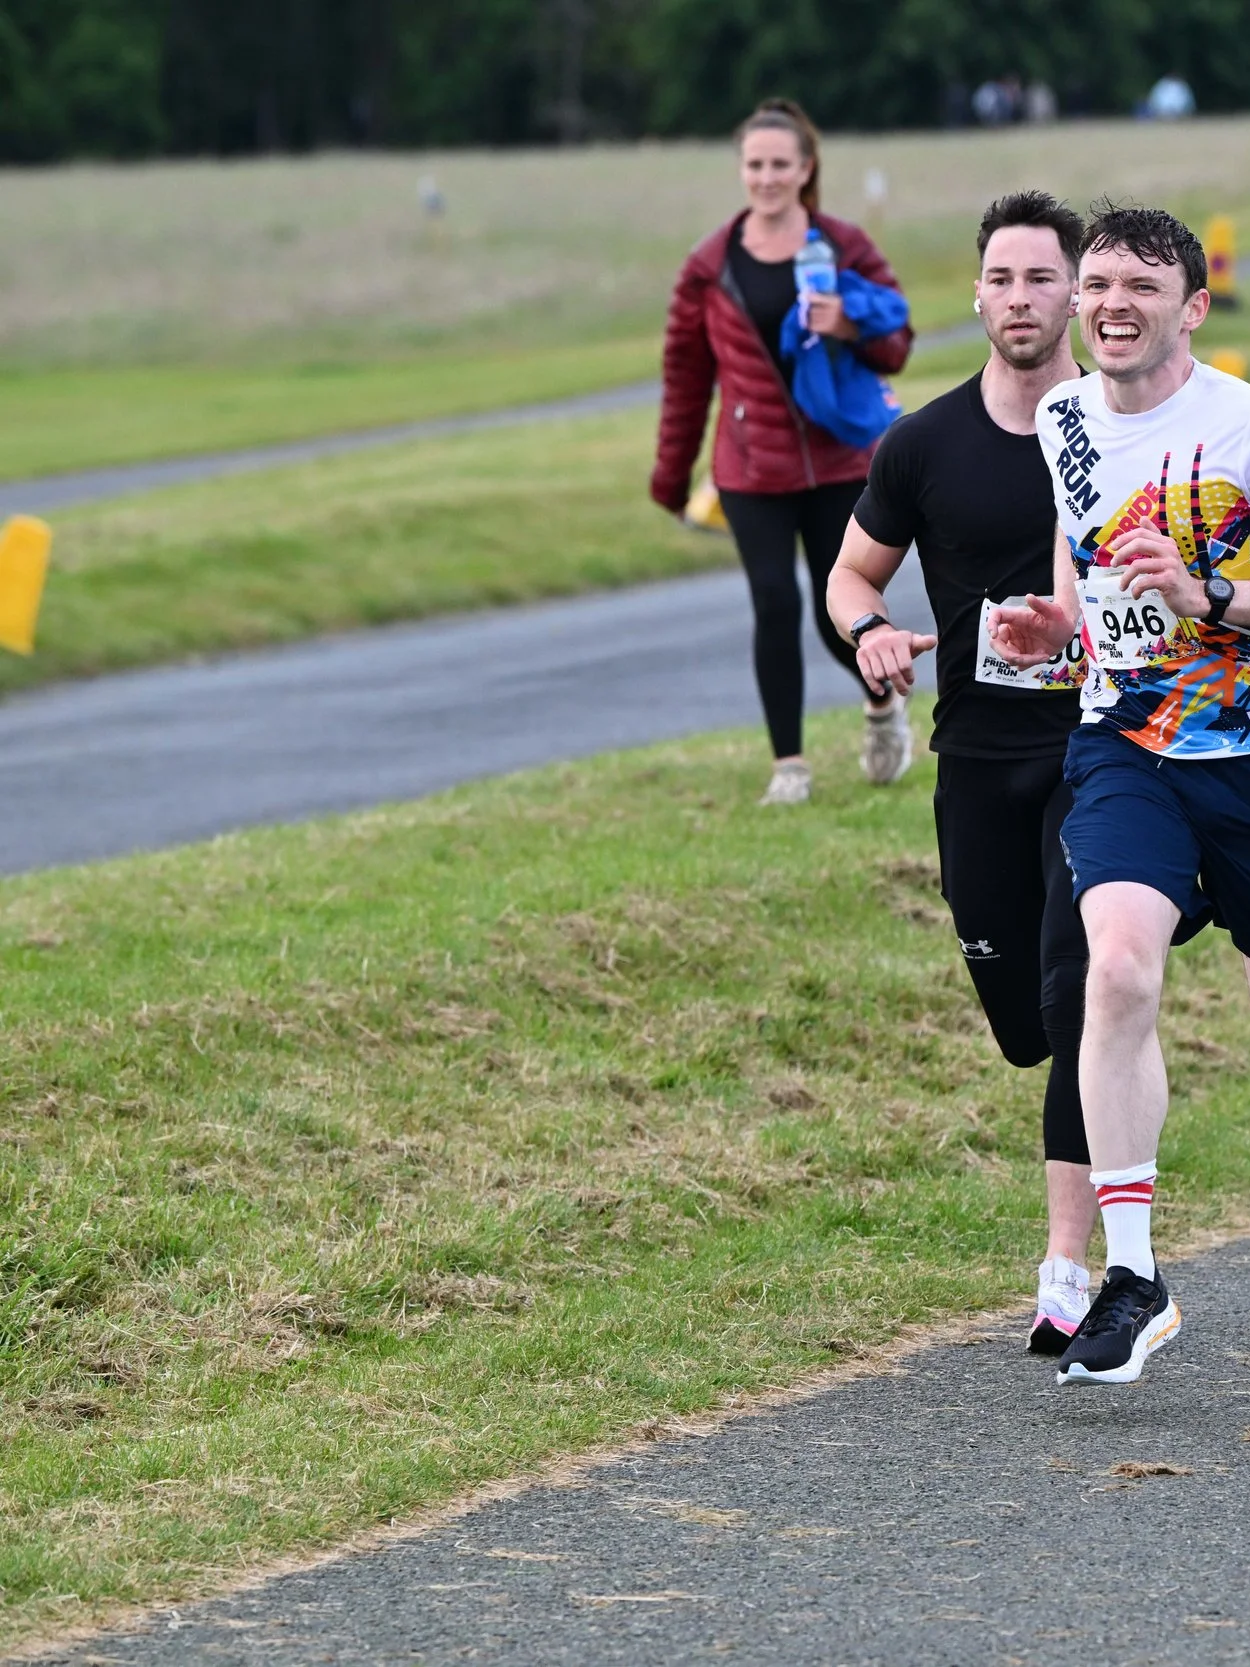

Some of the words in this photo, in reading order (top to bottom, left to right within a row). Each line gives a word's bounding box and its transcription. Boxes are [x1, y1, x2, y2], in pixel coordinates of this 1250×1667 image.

[1047, 398, 1102, 476] PRIDE
[1056, 447, 1102, 514] RUN
[1065, 496, 1084, 521] 2024
[1102, 604, 1165, 642] 946
[1098, 643, 1117, 651] PRIDE
[1110, 650, 1123, 658] RUN
[997, 667, 1018, 677] RUN
